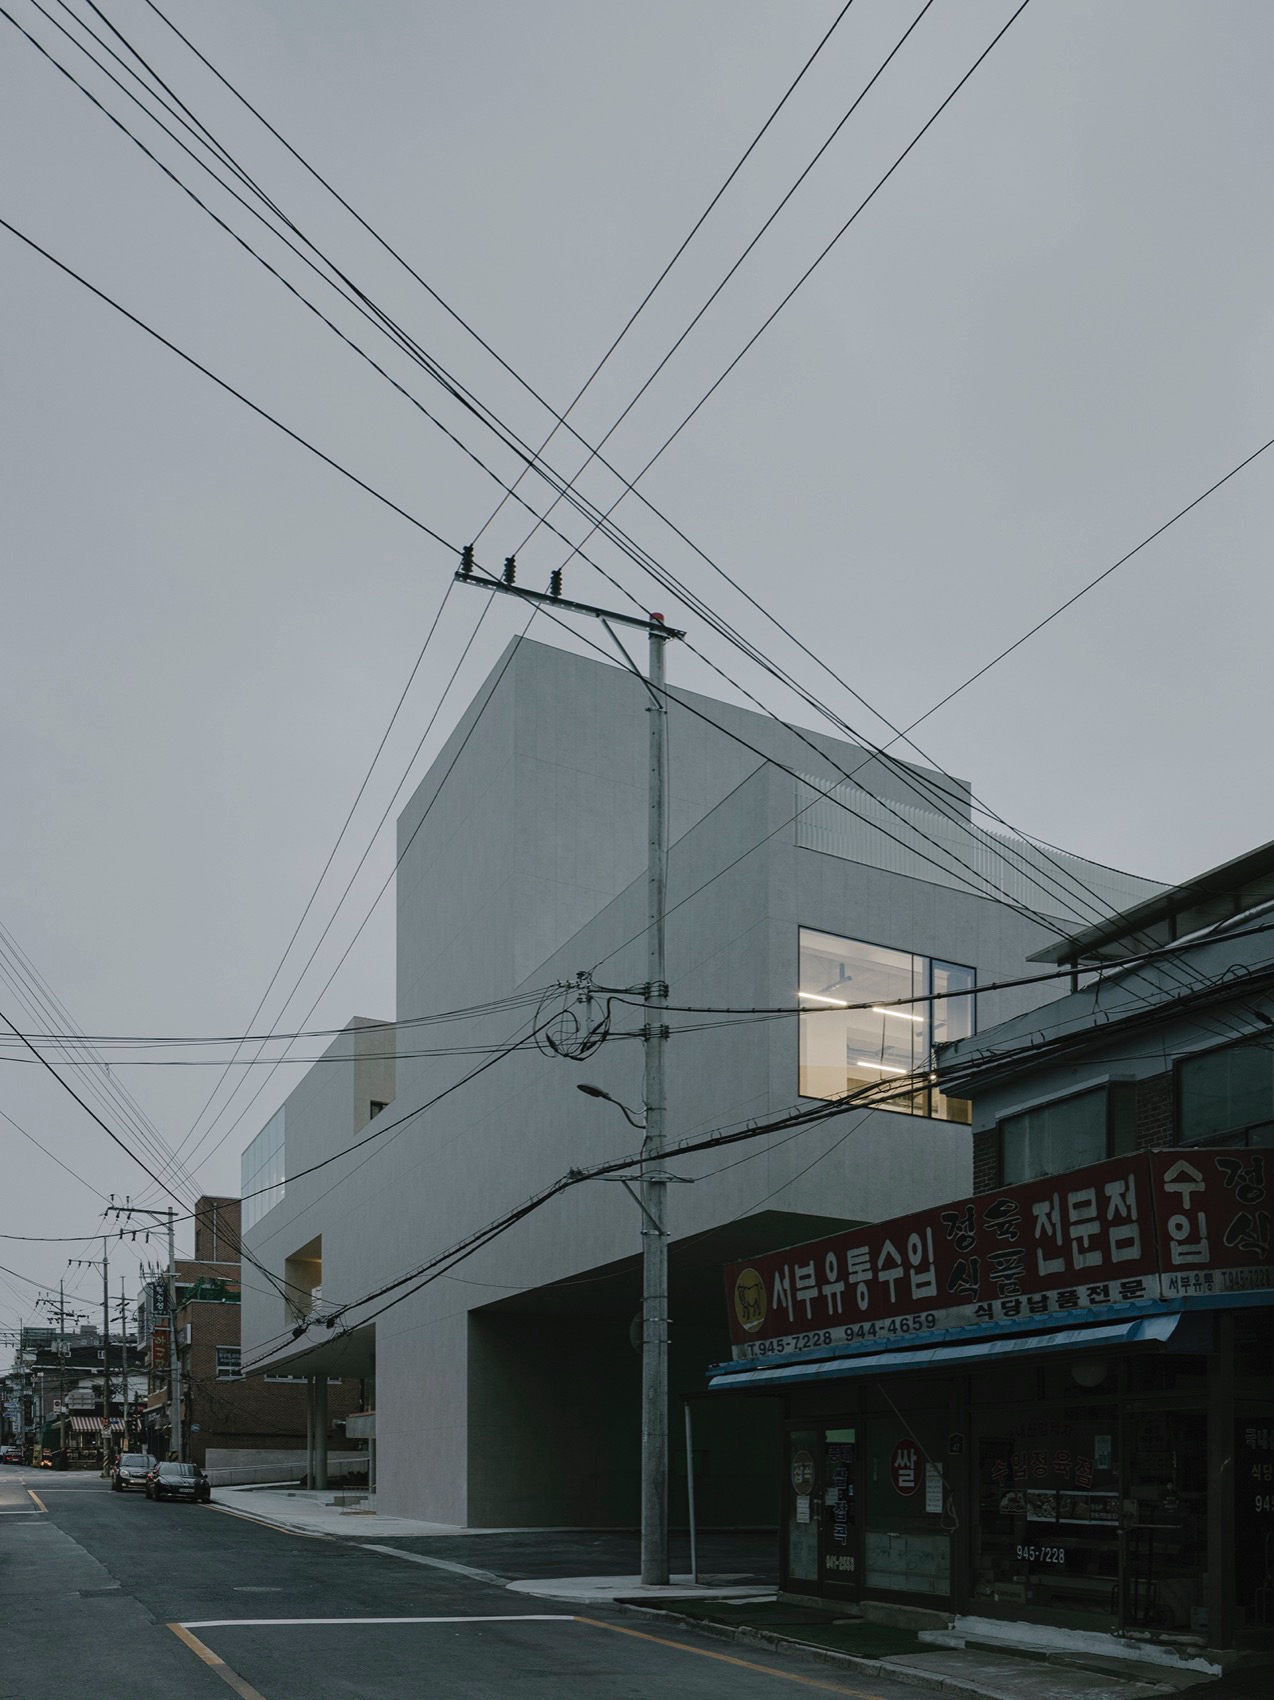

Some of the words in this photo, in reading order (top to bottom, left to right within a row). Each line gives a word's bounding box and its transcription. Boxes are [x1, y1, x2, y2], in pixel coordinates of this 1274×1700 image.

[1032, 1173, 1142, 1277] 전문점
[1164, 1159, 1211, 1266] 수입
[946, 1248, 1026, 1303] 식품
[1168, 1272, 1214, 1294] 서부유통
[844, 1312, 937, 1342] 944-4659
[894, 1448, 918, 1488] 쌀
[991, 1449, 1095, 1489] 수입정육점
[1016, 1545, 1066, 1564] 945-7228
